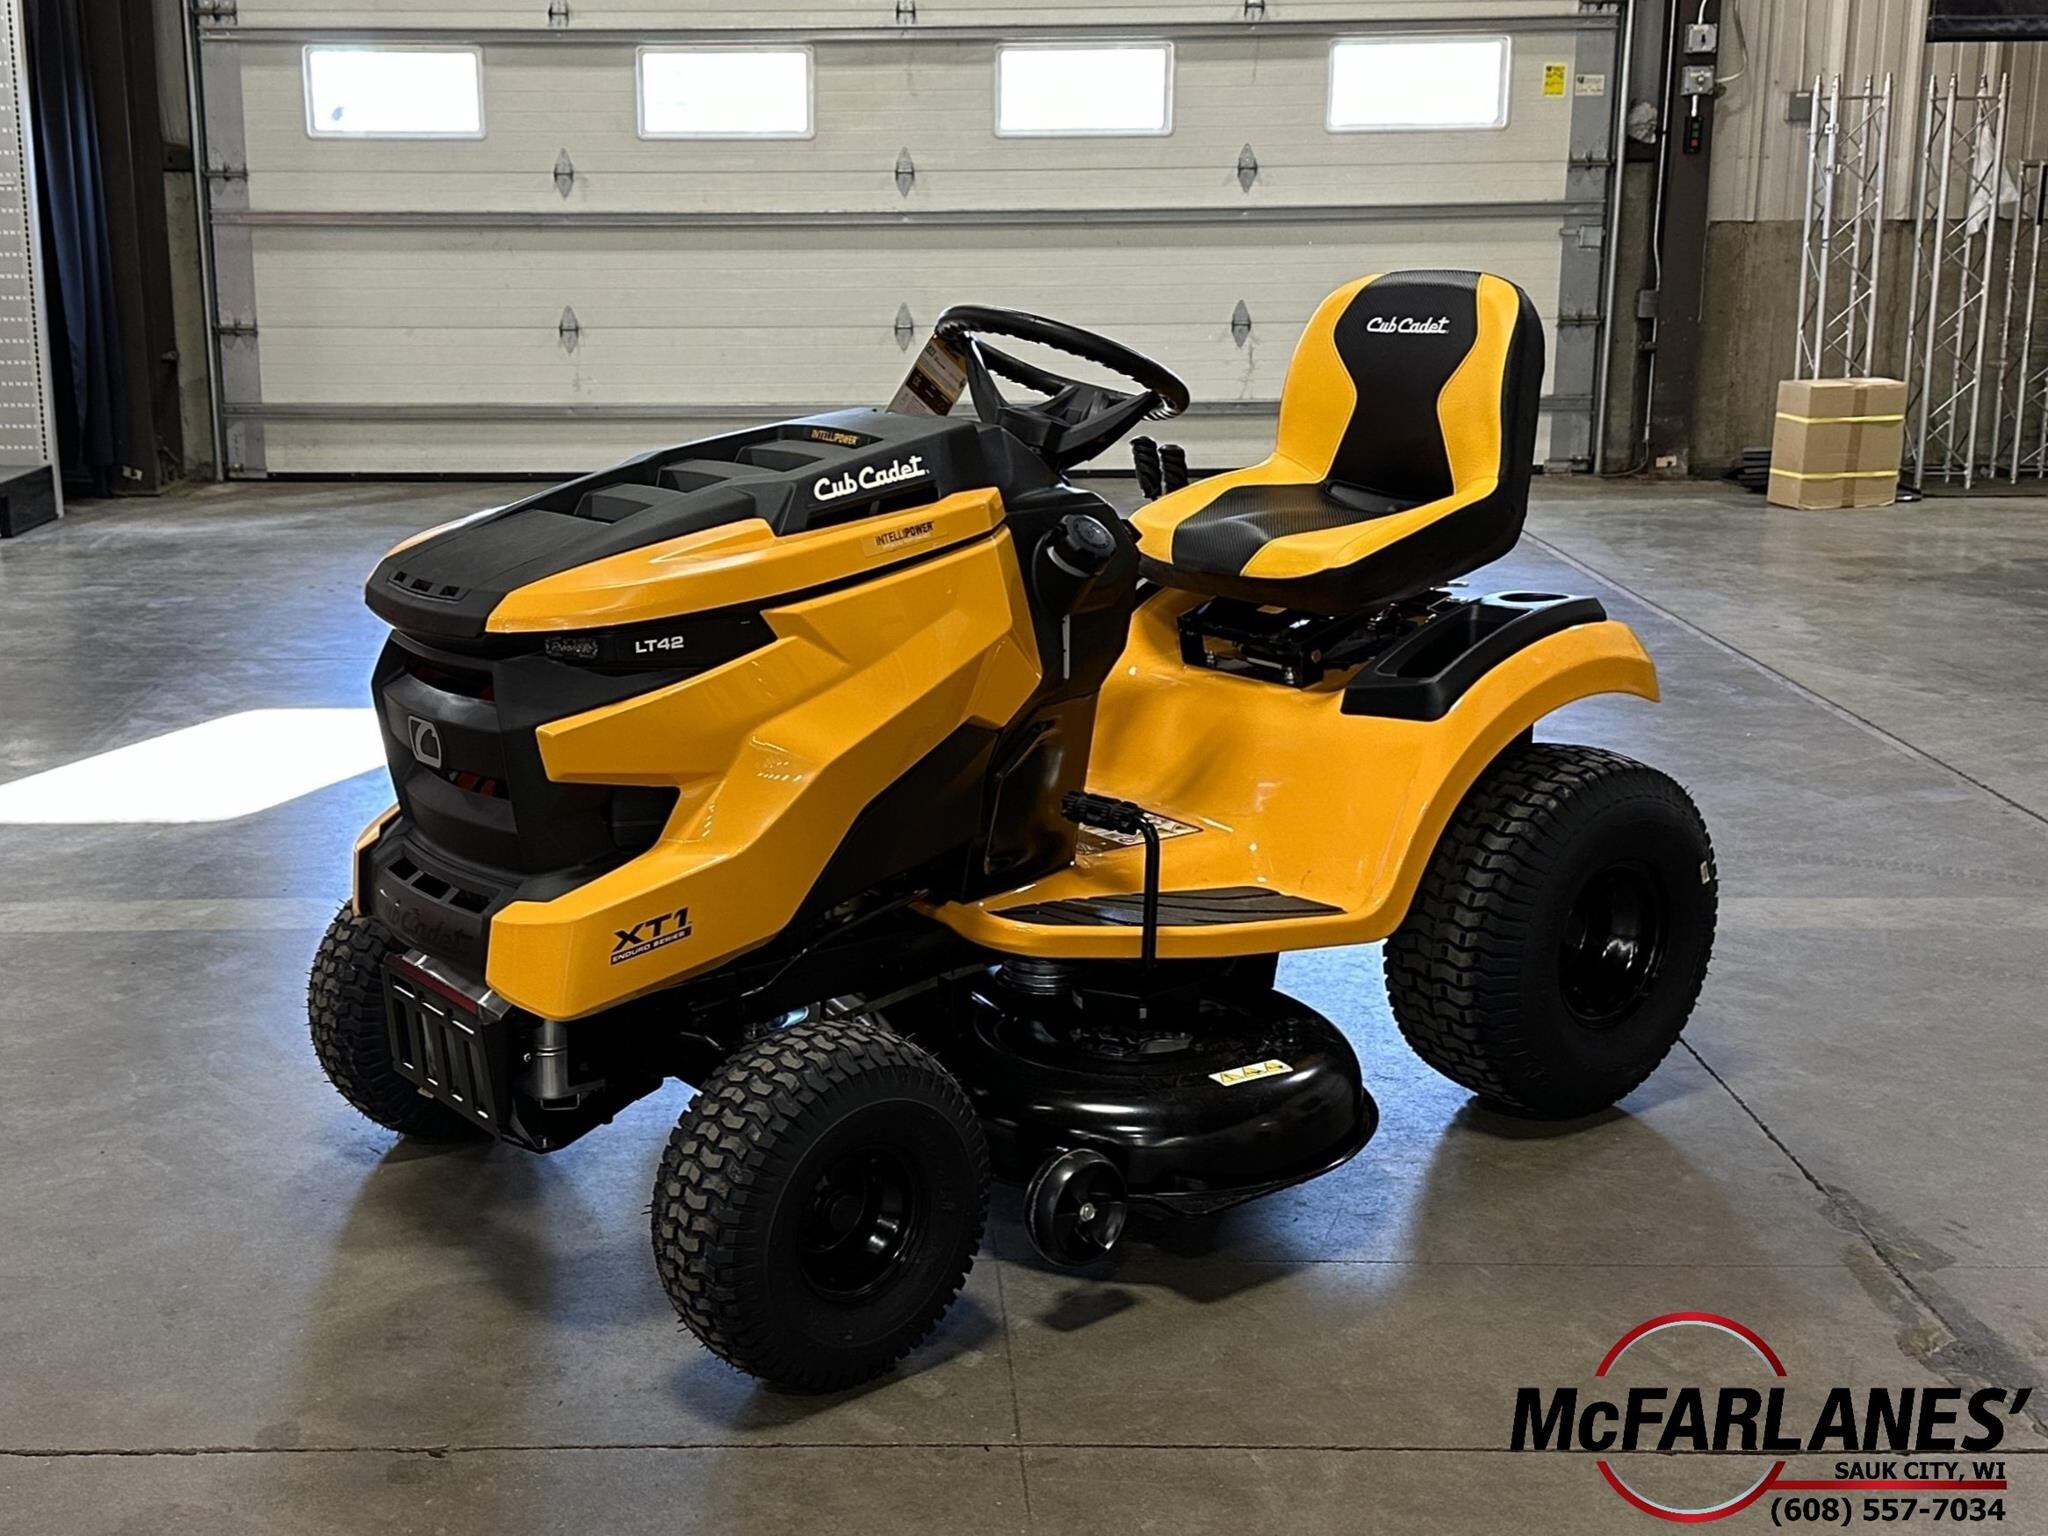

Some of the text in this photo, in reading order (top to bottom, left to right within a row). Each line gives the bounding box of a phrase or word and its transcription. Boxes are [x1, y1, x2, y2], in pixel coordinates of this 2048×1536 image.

[1366, 316, 1450, 334] Cub Cadet
[811, 429, 859, 446] INTELLIPOWER
[813, 455, 927, 501] Cub Cadet
[875, 520, 935, 546] INTELLIPOWER
[635, 636, 685, 654] LT42
[612, 906, 688, 952] XT1
[612, 930, 686, 963] ENDURO SERIES
